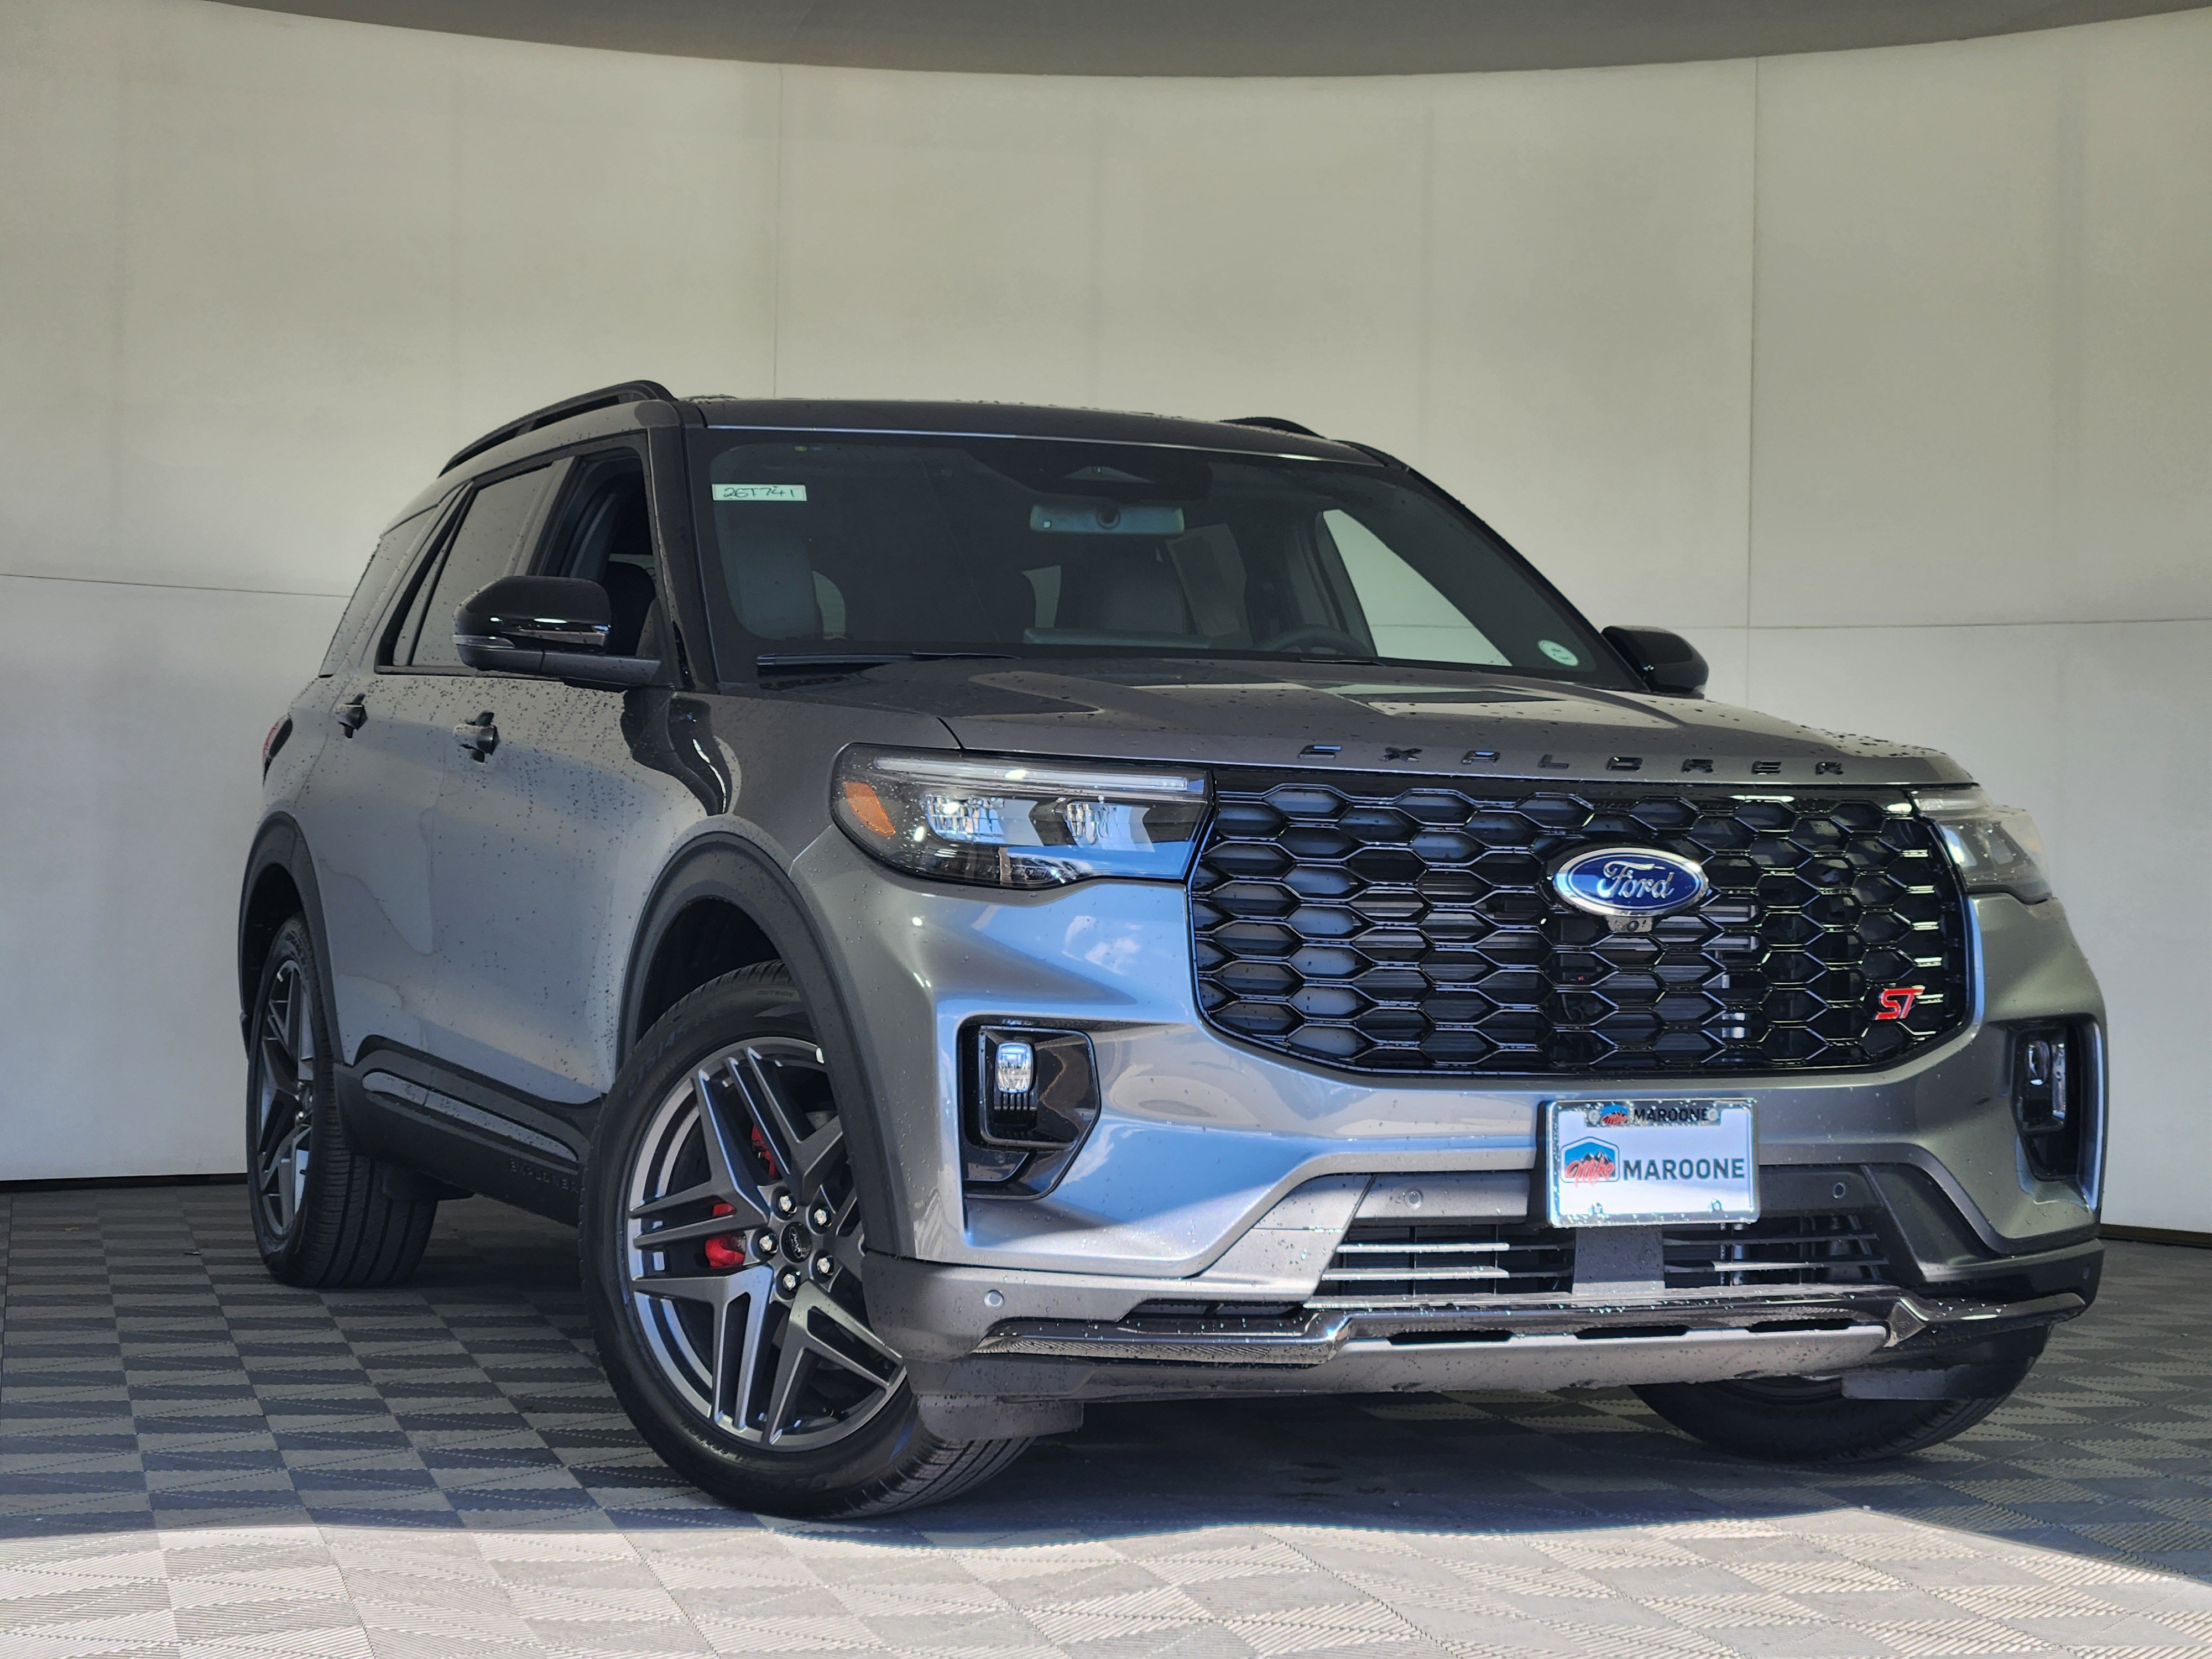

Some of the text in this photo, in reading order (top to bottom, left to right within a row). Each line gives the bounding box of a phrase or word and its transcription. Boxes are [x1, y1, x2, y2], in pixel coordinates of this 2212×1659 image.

[1297, 744, 1844, 775] EXPLORER
[1597, 860, 1675, 899] Ford
[1875, 984, 1926, 1020] ST
[1633, 1108, 1709, 1123] MAROONE
[1566, 1156, 1746, 1186] Mike MAROONE
